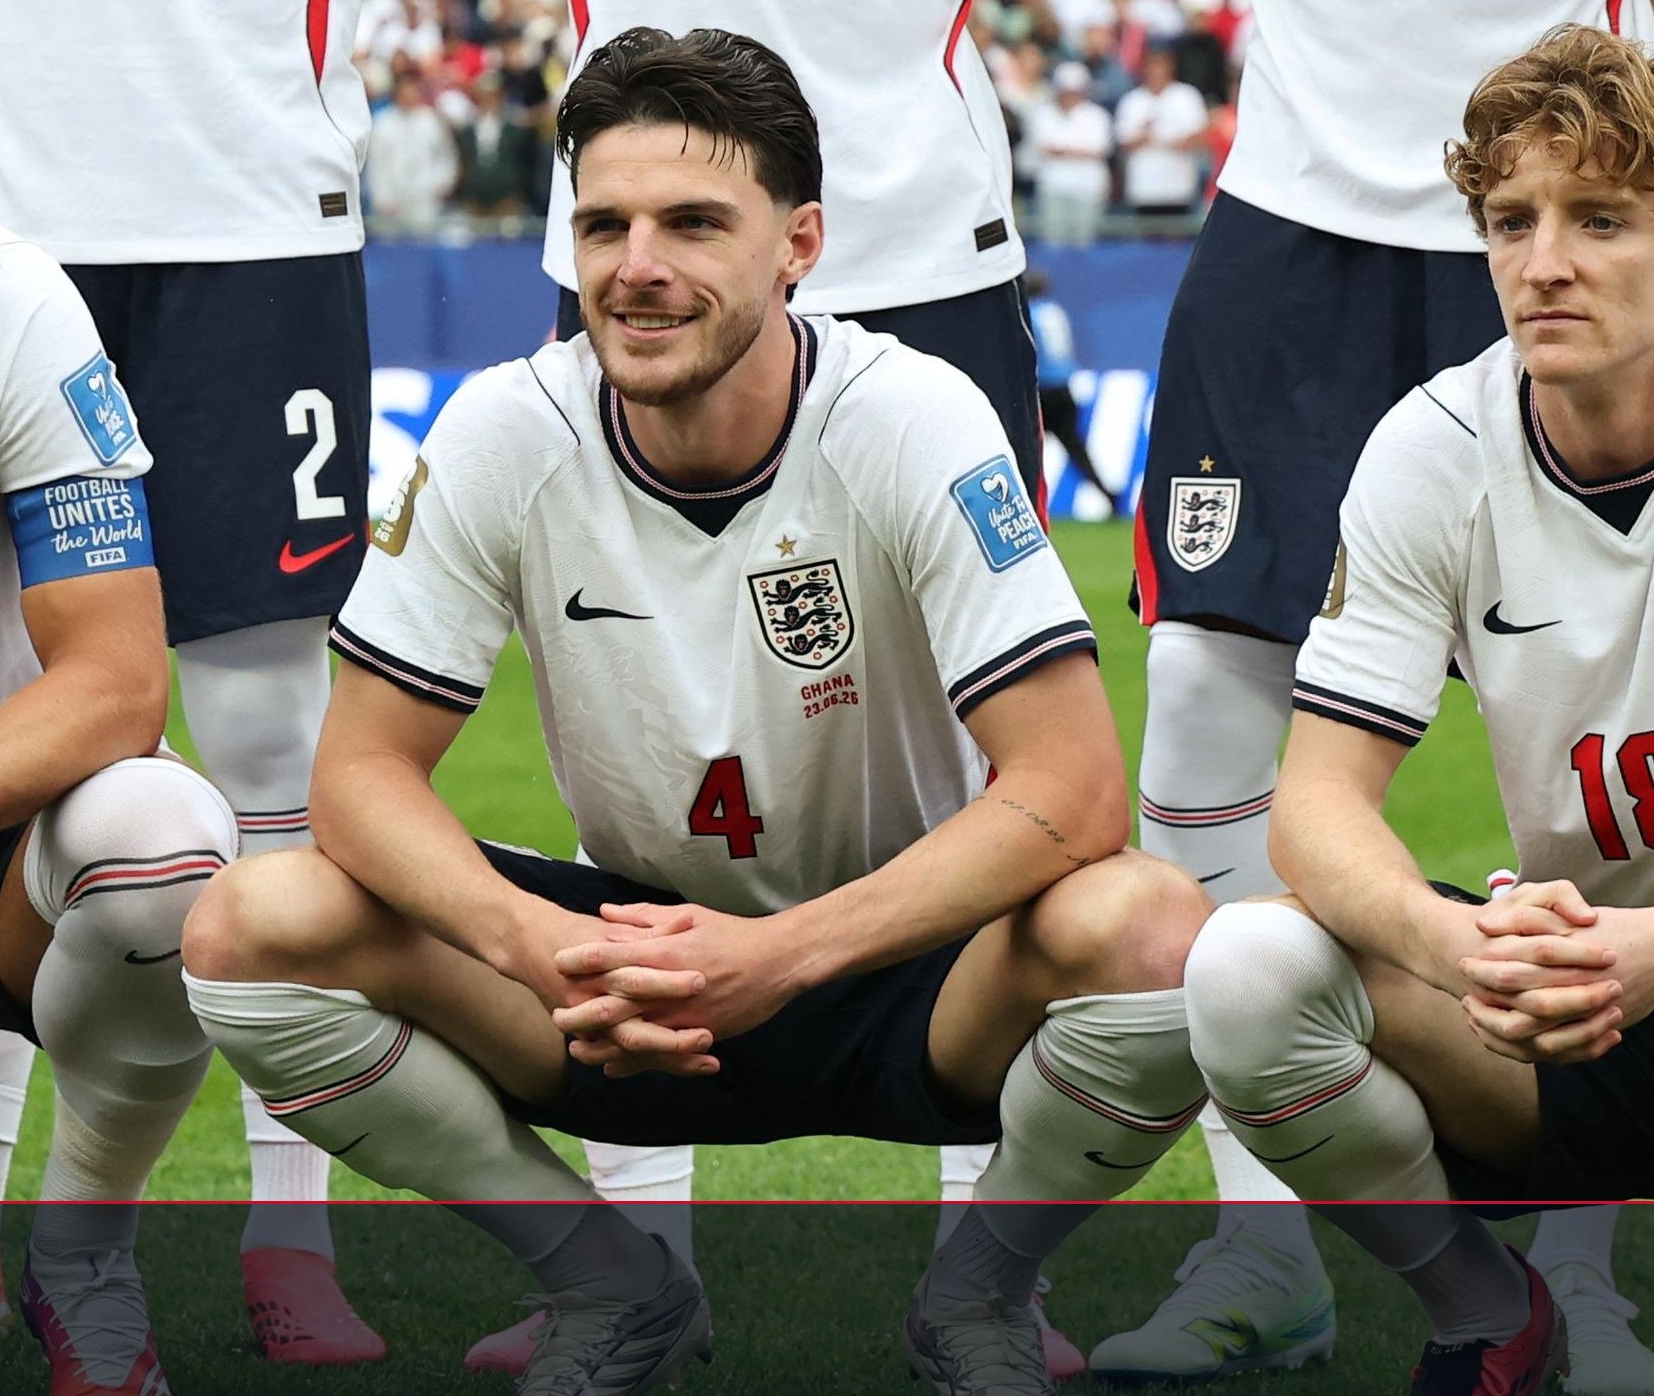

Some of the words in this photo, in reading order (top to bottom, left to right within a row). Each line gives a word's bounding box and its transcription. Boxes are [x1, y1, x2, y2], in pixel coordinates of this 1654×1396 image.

[283, 388, 346, 521] 2
[45, 477, 130, 506] FOOTBALL
[48, 494, 136, 531] UNITES
[51, 532, 88, 553] the
[89, 519, 144, 547] World
[90, 550, 124, 565] FIFA
[800, 673, 855, 701] GHANA
[803, 690, 859, 719] 23.06.26
[687, 755, 765, 860] 4
